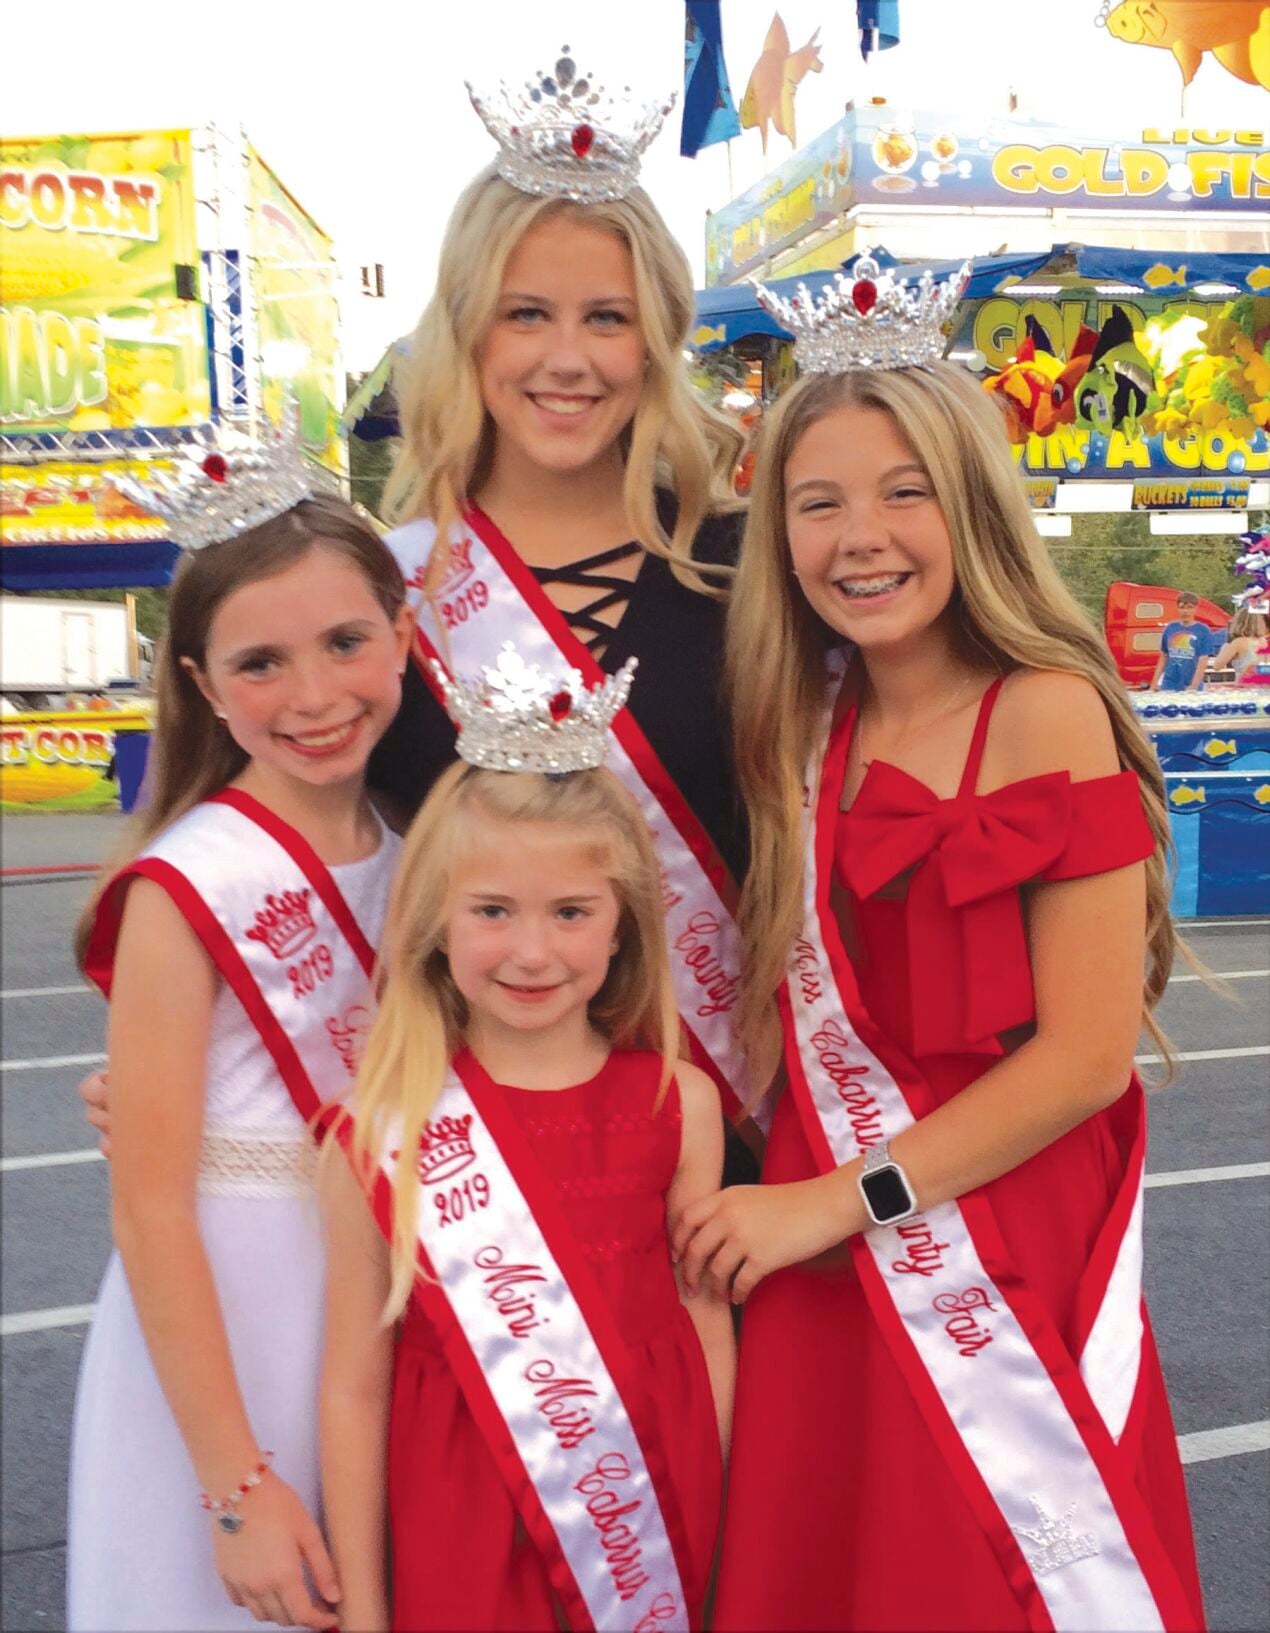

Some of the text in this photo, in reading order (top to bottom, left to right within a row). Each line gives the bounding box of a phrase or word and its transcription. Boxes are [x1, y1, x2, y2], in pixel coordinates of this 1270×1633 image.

[991, 145, 1170, 198] GOLD
[0, 167, 158, 241] CORN
[1105, 430, 1151, 469] A
[442, 580, 489, 629] 2019
[287, 943, 335, 1000] 2019
[673, 911, 741, 1017] County
[433, 1173, 491, 1228] 2019
[811, 1019, 884, 1155] Cabarru
[891, 1221, 950, 1277] unty
[932, 1286, 998, 1358] Fair
[474, 1245, 551, 1338] Mini
[525, 1359, 598, 1450] Miss
[573, 1451, 650, 1602] Cabarrus
